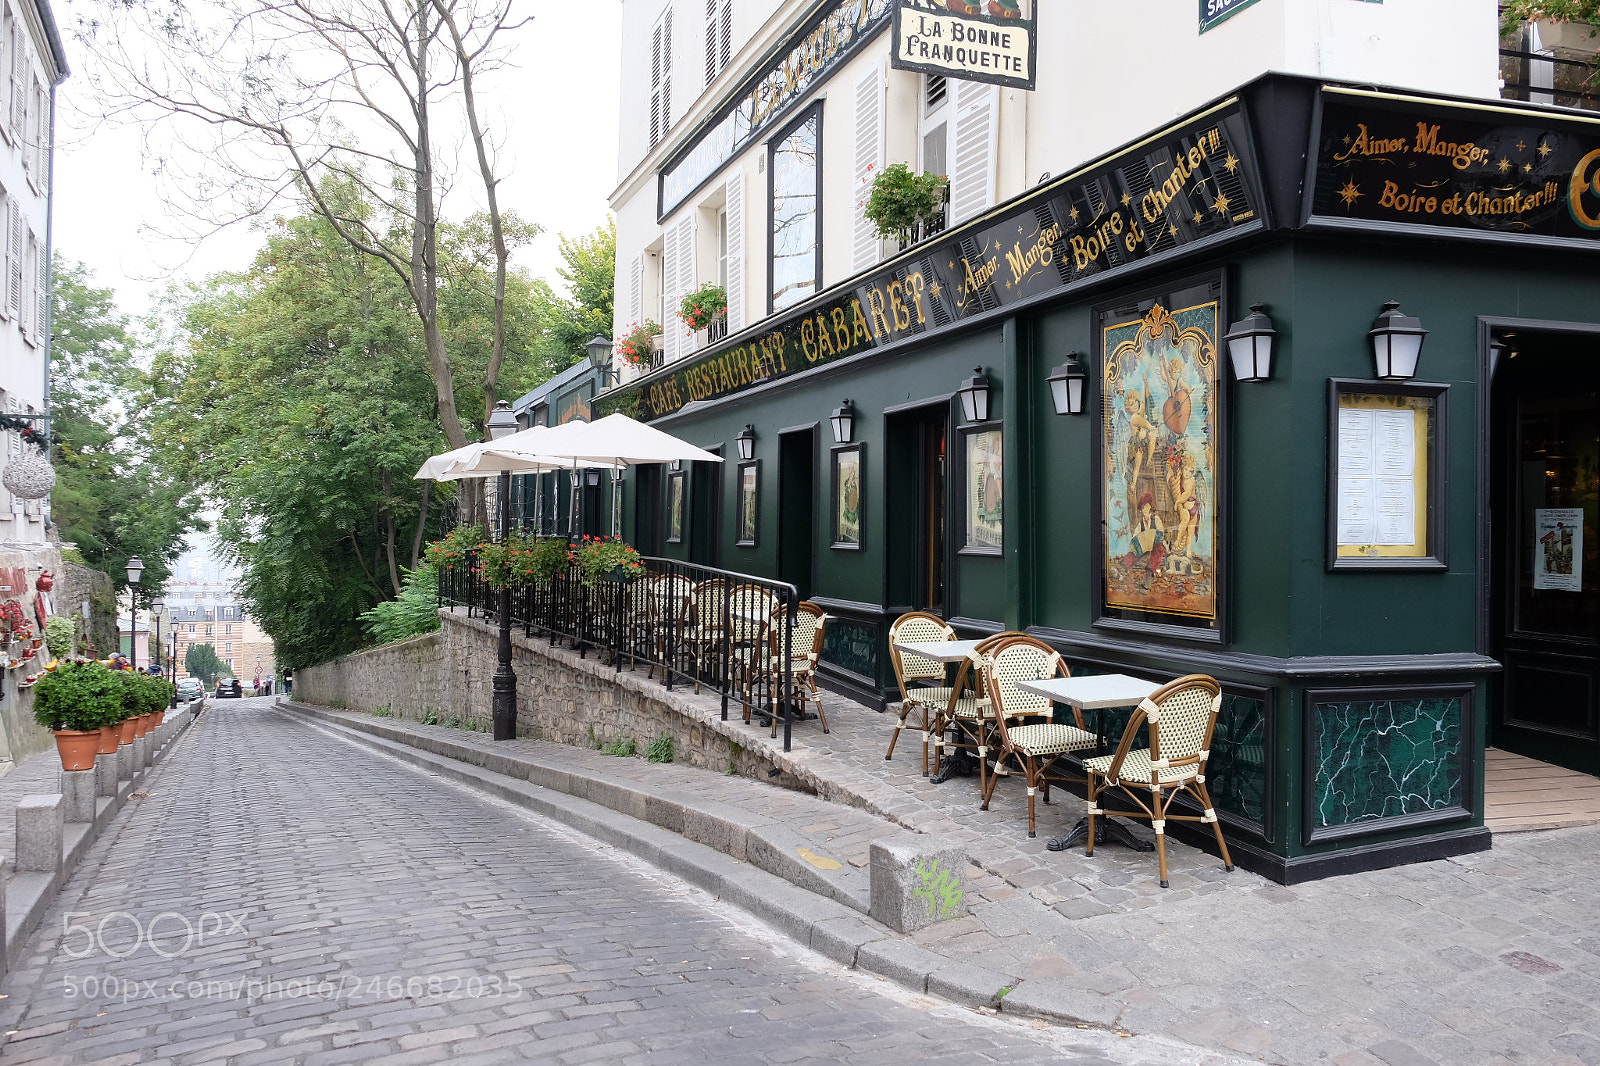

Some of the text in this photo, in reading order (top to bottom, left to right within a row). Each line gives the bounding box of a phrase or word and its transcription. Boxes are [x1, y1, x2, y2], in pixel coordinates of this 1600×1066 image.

[917, 15, 1011, 49] LA BONNE
[903, 34, 1022, 72] FRANQUETTE
[1334, 121, 1489, 170] Aimer, Manger,
[1378, 179, 1437, 213] Boire
[1441, 197, 1463, 215] et
[684, 331, 787, 402] RESTAURANT
[800, 271, 926, 362] CABARET
[956, 255, 1000, 307] Aimer,
[1005, 222, 1063, 285] Manger,
[1069, 211, 1124, 272] Boire
[1125, 217, 1145, 252] et
